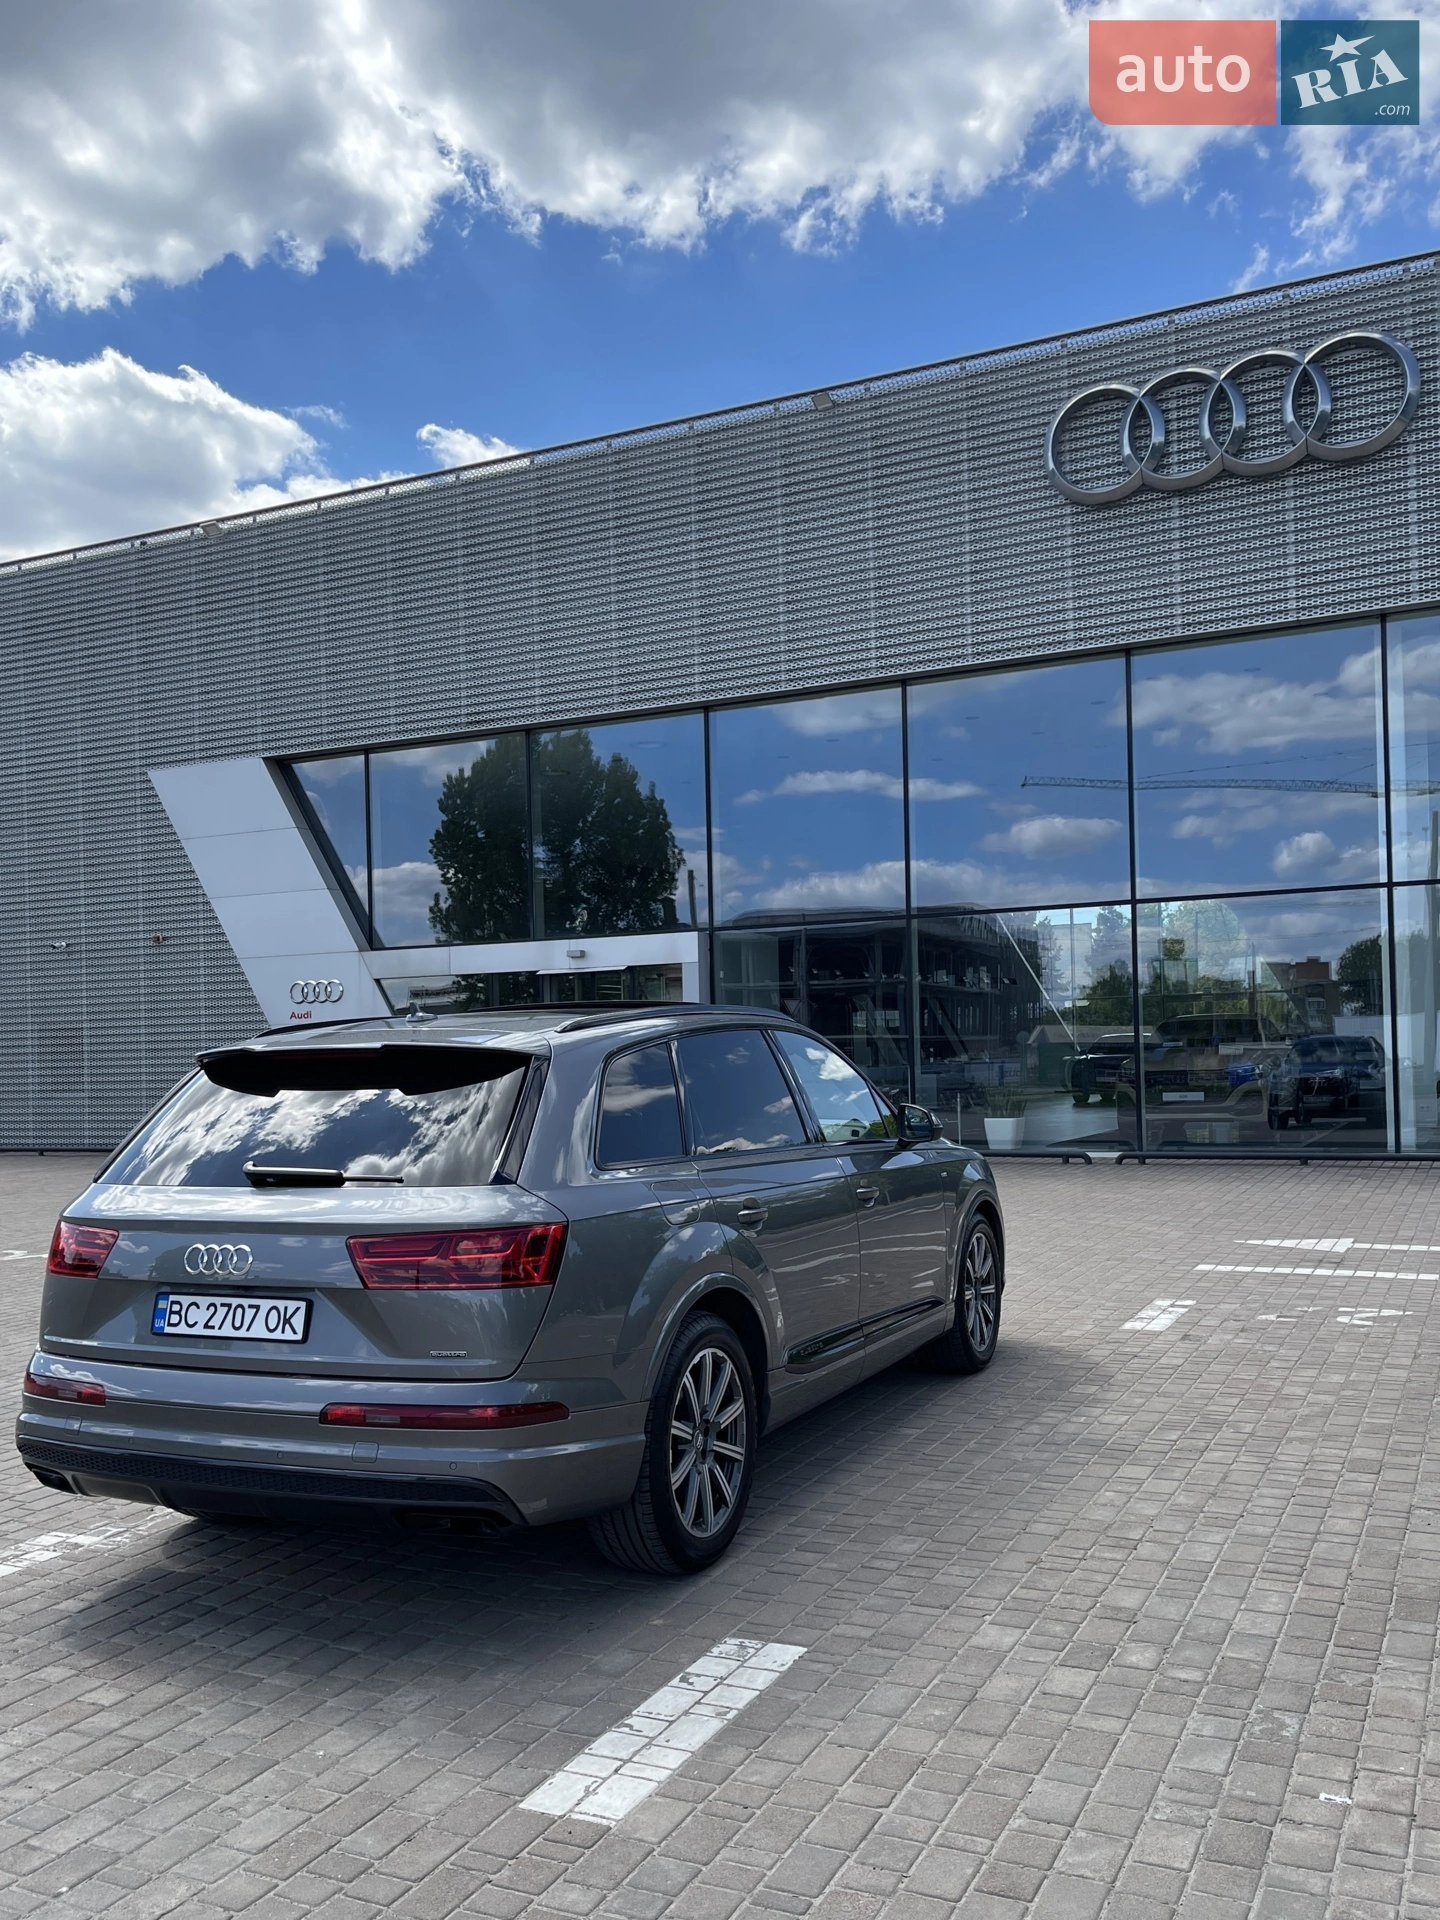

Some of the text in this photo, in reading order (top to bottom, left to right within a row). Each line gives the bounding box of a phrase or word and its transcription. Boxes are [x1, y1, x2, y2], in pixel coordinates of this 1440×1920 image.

[289, 1010, 312, 1020] Audi
[167, 1300, 302, 1335] BC 2707 OK
[155, 1318, 165, 1328] UA
